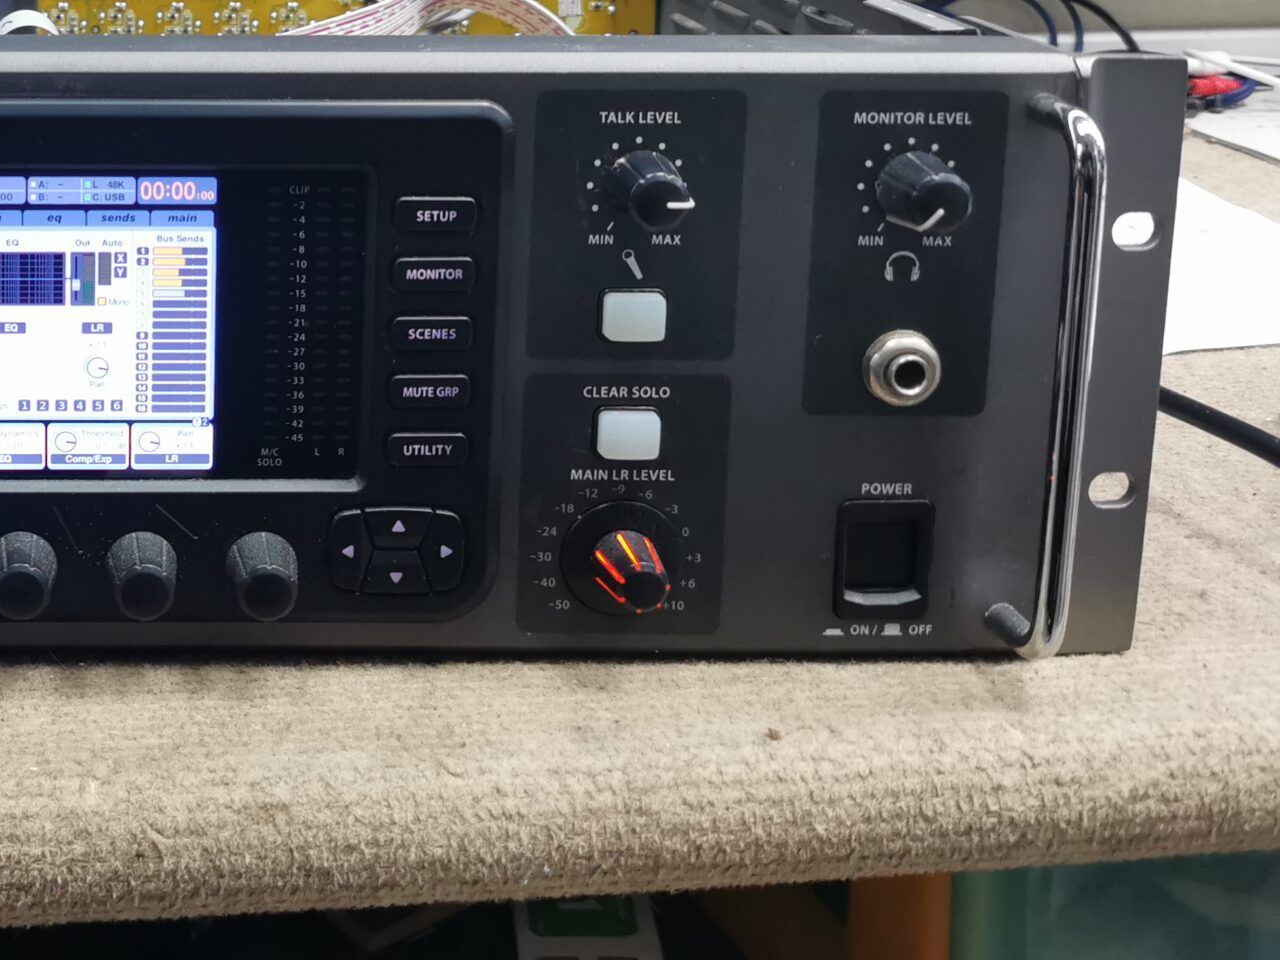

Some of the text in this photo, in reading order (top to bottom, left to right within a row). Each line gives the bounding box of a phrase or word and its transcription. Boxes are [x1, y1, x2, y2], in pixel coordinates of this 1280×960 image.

[599, 111, 682, 124] TALK LEVEL
[853, 111, 972, 125] MONITOR LEVEL
[106, 180, 125, 189] 48K
[289, 185, 311, 194] CLIP
[104, 192, 126, 202] USB
[46, 214, 62, 225] eq
[101, 213, 136, 223] sends
[167, 213, 198, 223] main
[416, 210, 458, 222] SETUP
[101, 239, 123, 248] Auto
[156, 234, 205, 243] Bus Sends
[588, 234, 614, 246] MIN
[651, 234, 682, 246] MAX
[857, 235, 884, 247] MIN
[922, 235, 953, 247] MAX
[5, 239, 19, 249] EQ
[405, 268, 464, 281] MONITOR
[4, 323, 18, 333] EQ
[90, 323, 104, 332] LR
[408, 328, 457, 340] SCENES
[402, 387, 460, 397] MUTE GRP
[582, 386, 671, 398] CLEAR SOLO
[260, 447, 279, 457] M/C
[403, 444, 454, 456] UTILITY
[65, 454, 112, 464] Comp/Exp
[165, 454, 179, 463] LR
[257, 458, 283, 467] SOLO
[570, 469, 676, 481] MAIN LR LEVEL
[861, 482, 913, 495] POWER
[681, 527, 690, 537] 0
[849, 624, 869, 635] ON
[908, 624, 933, 635] OFF
